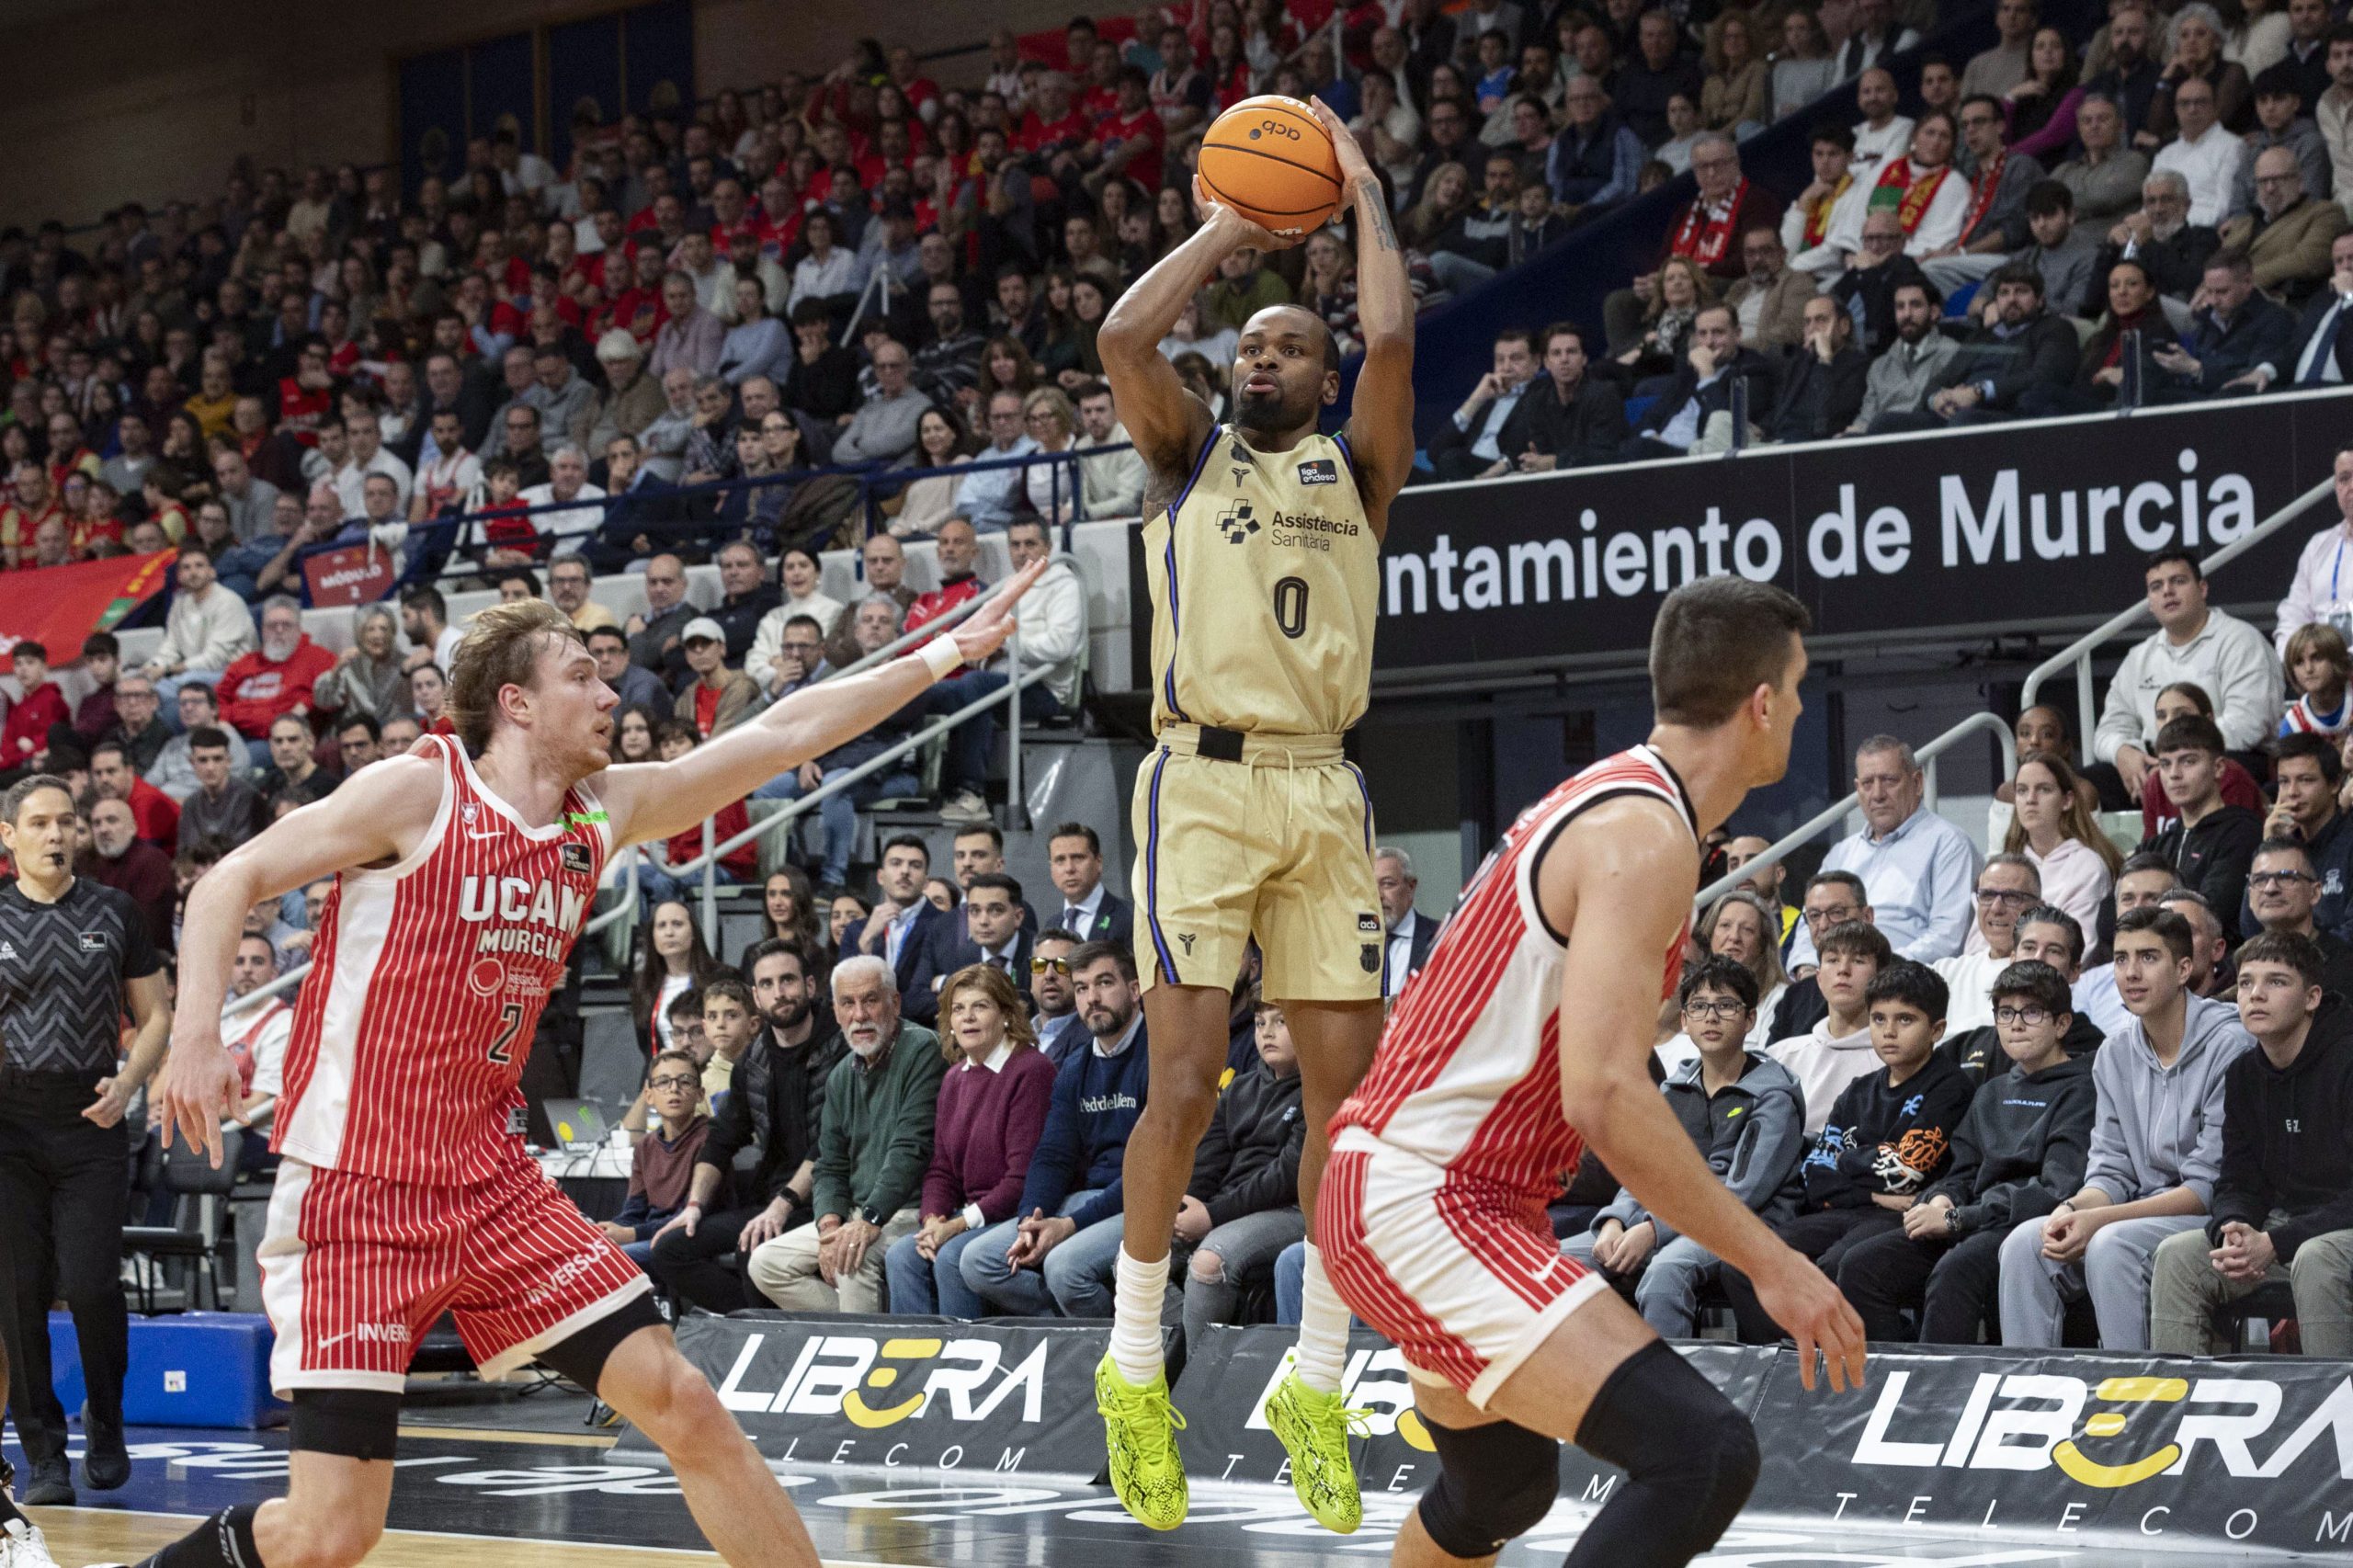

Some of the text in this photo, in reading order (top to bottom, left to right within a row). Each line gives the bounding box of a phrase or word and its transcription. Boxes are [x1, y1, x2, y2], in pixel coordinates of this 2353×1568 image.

[1262, 120, 1301, 141] acb
[1301, 468, 1318, 476] liga
[1302, 473, 1336, 483] endesa
[1271, 529, 1331, 551] Sanitària
[1272, 511, 1358, 537] Assistència
[1386, 448, 2256, 616] ntamiento de Murcia
[1274, 576, 1309, 639] 0
[460, 875, 585, 939] UCAM
[1360, 920, 1377, 929] acb
[478, 928, 563, 963] MURCIA
[488, 1002, 524, 1064] 2
[527, 1239, 610, 1304] INVERSUS
[717, 1333, 1048, 1429] LIBERA
[1850, 1370, 2353, 1488] LIBERA
[745, 1434, 1027, 1471] LECOM
[1832, 1493, 2353, 1543] TELECOM
